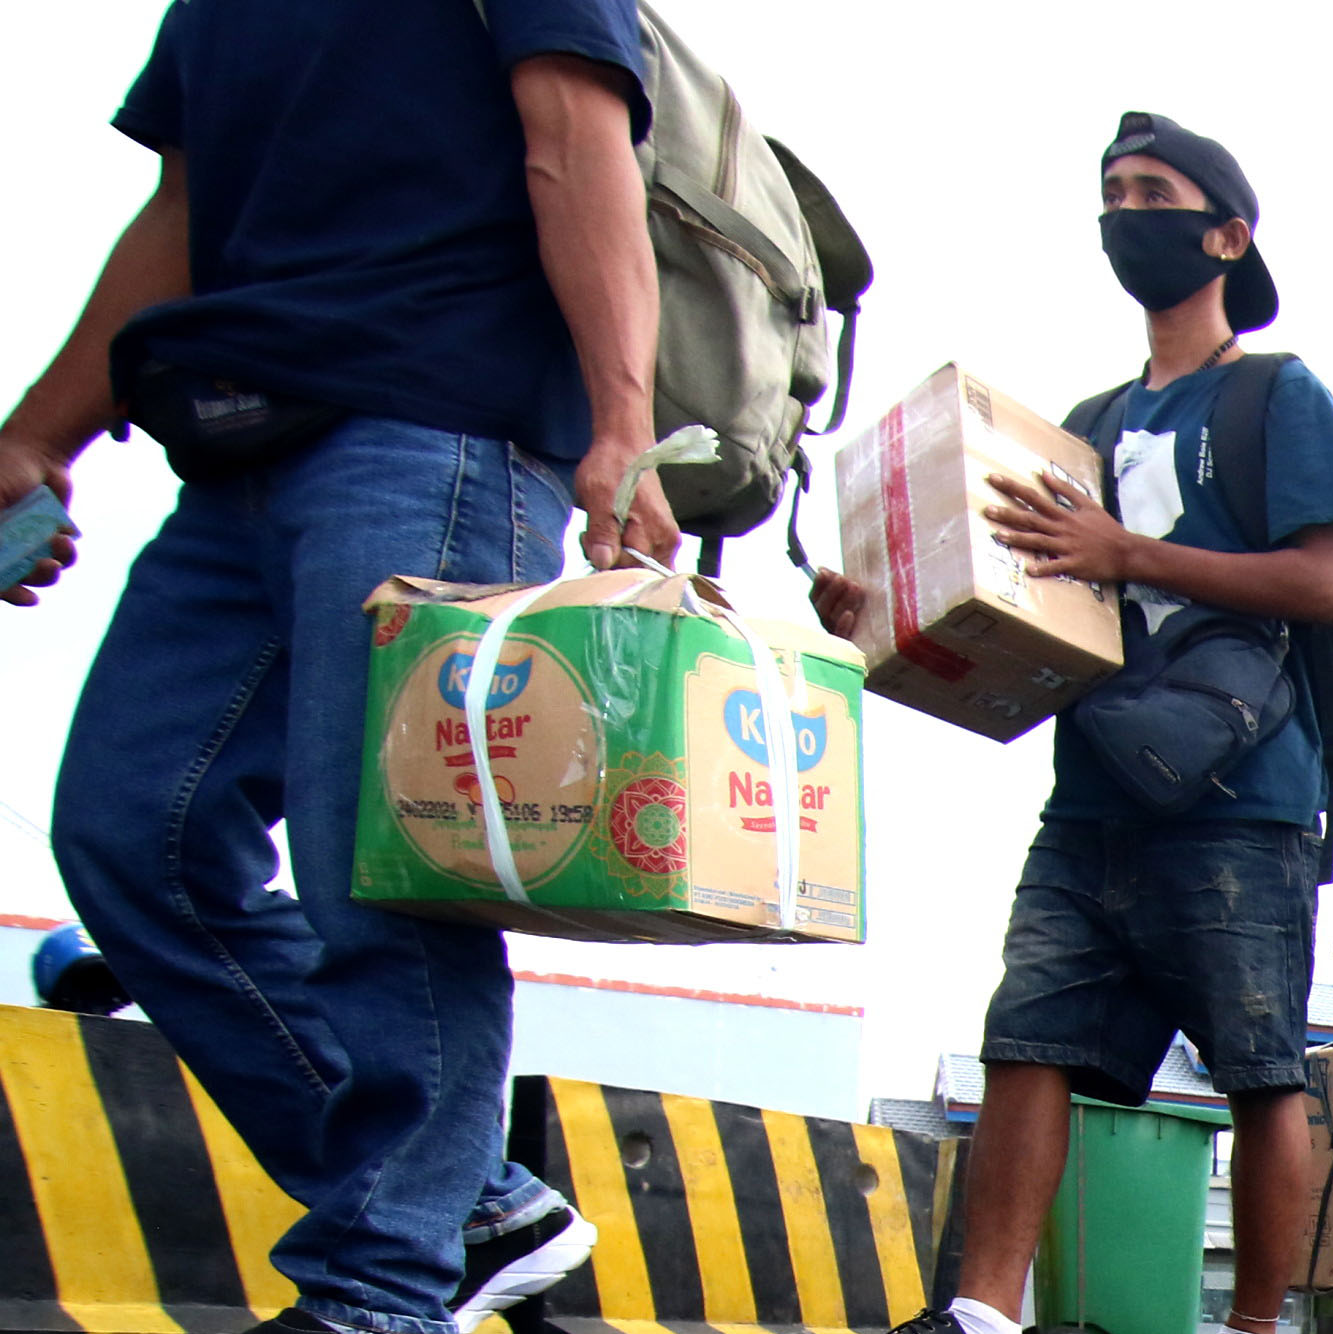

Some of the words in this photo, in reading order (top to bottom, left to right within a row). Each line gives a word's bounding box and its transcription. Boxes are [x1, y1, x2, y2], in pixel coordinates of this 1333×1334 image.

[447, 661, 519, 697] Kno
[435, 713, 532, 752] Natar
[739, 703, 817, 757] Ko
[728, 769, 831, 811] Naar
